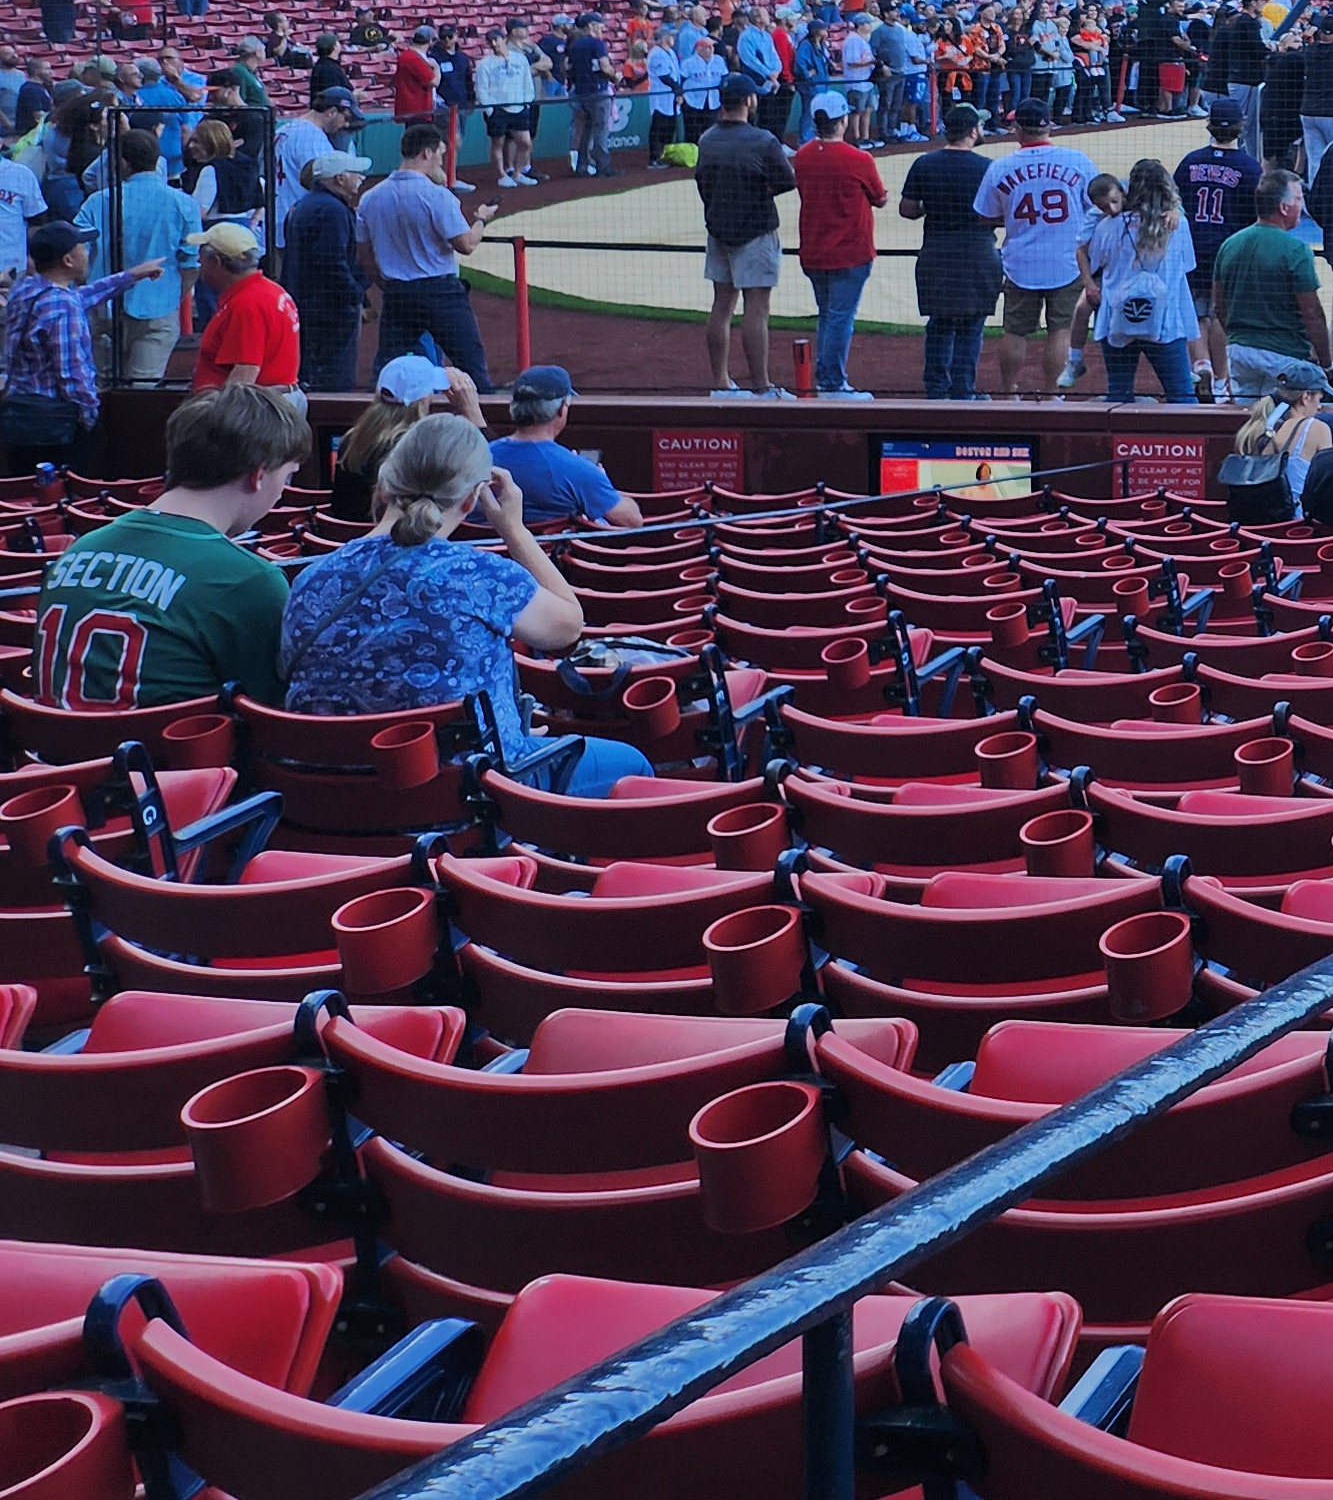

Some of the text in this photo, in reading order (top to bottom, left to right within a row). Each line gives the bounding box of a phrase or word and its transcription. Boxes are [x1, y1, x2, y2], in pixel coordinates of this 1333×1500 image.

[996, 162, 1081, 196] WAKEFIELD
[1189, 163, 1243, 188] DEVERS
[1014, 189, 1070, 226] 49
[1195, 186, 1225, 225] 11
[659, 438, 738, 450] CAUTION!
[1117, 443, 1203, 457] CAUTION!
[47, 550, 187, 612] SECTION
[34, 603, 149, 711] 10
